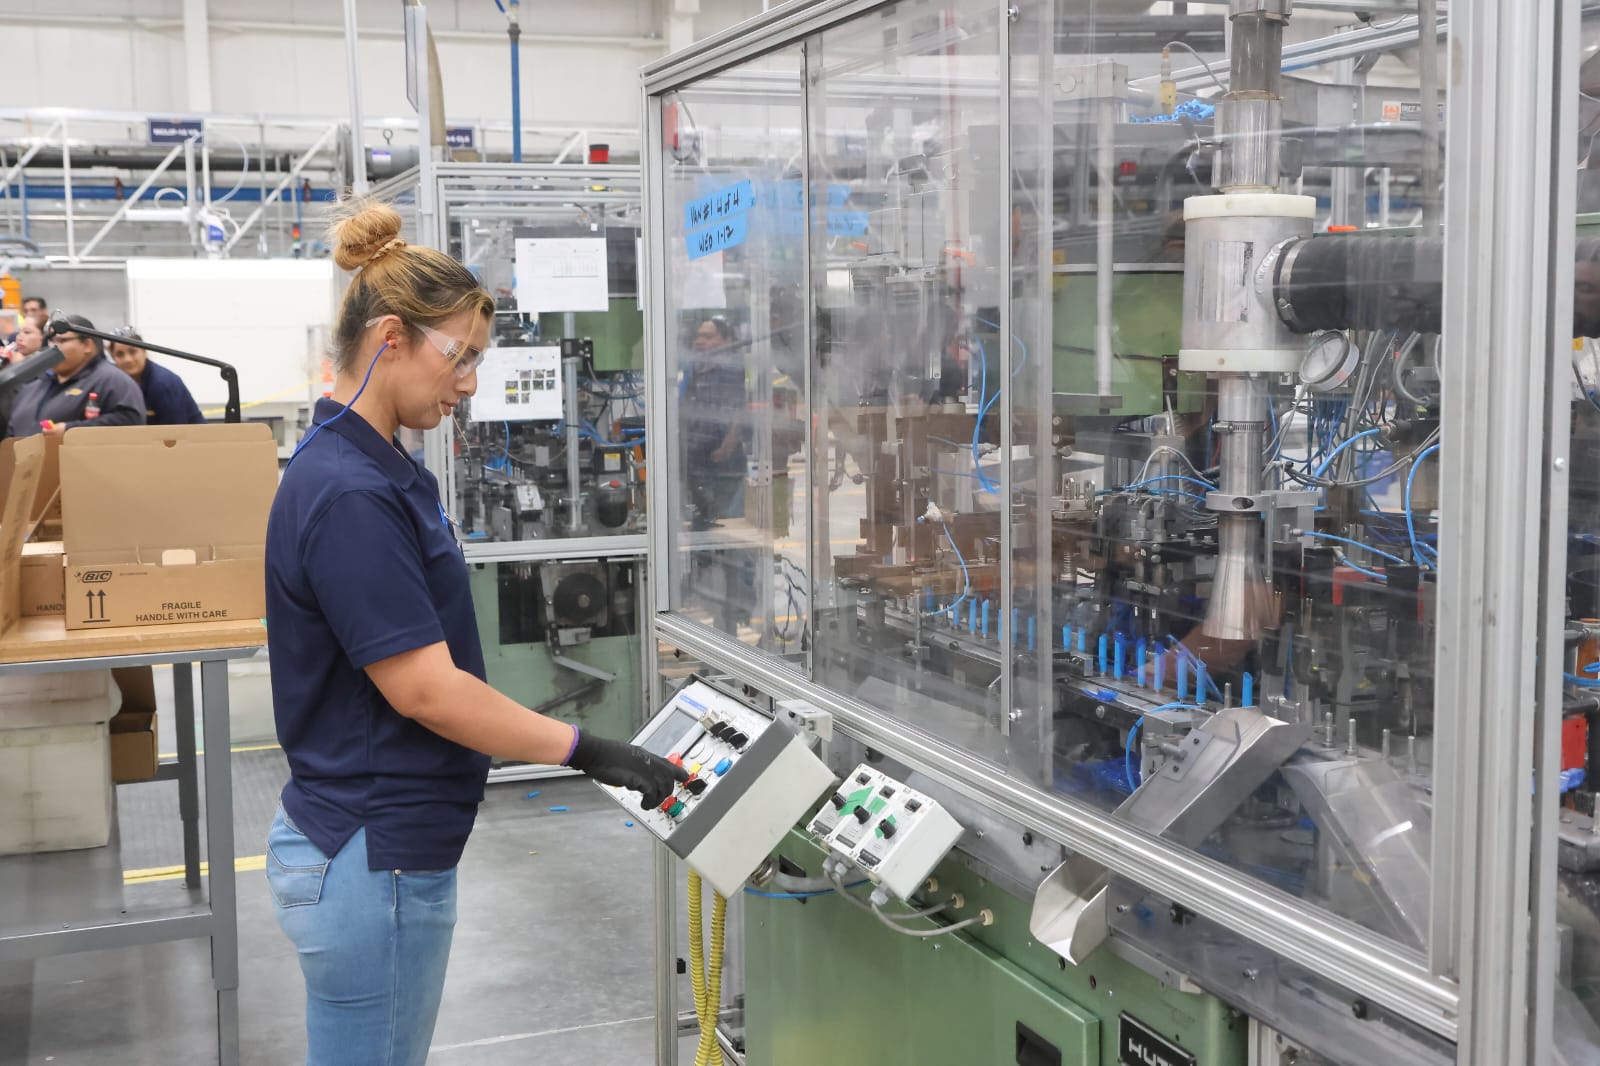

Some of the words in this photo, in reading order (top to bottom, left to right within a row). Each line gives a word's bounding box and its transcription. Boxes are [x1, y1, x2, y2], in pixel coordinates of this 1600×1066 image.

[733, 187, 739, 207] 4
[699, 232, 713, 252] WED
[161, 601, 201, 611] FRAGILE
[135, 611, 174, 622] HANDLE
[176, 611, 201, 620] WITH
[203, 609, 228, 619] CARE
